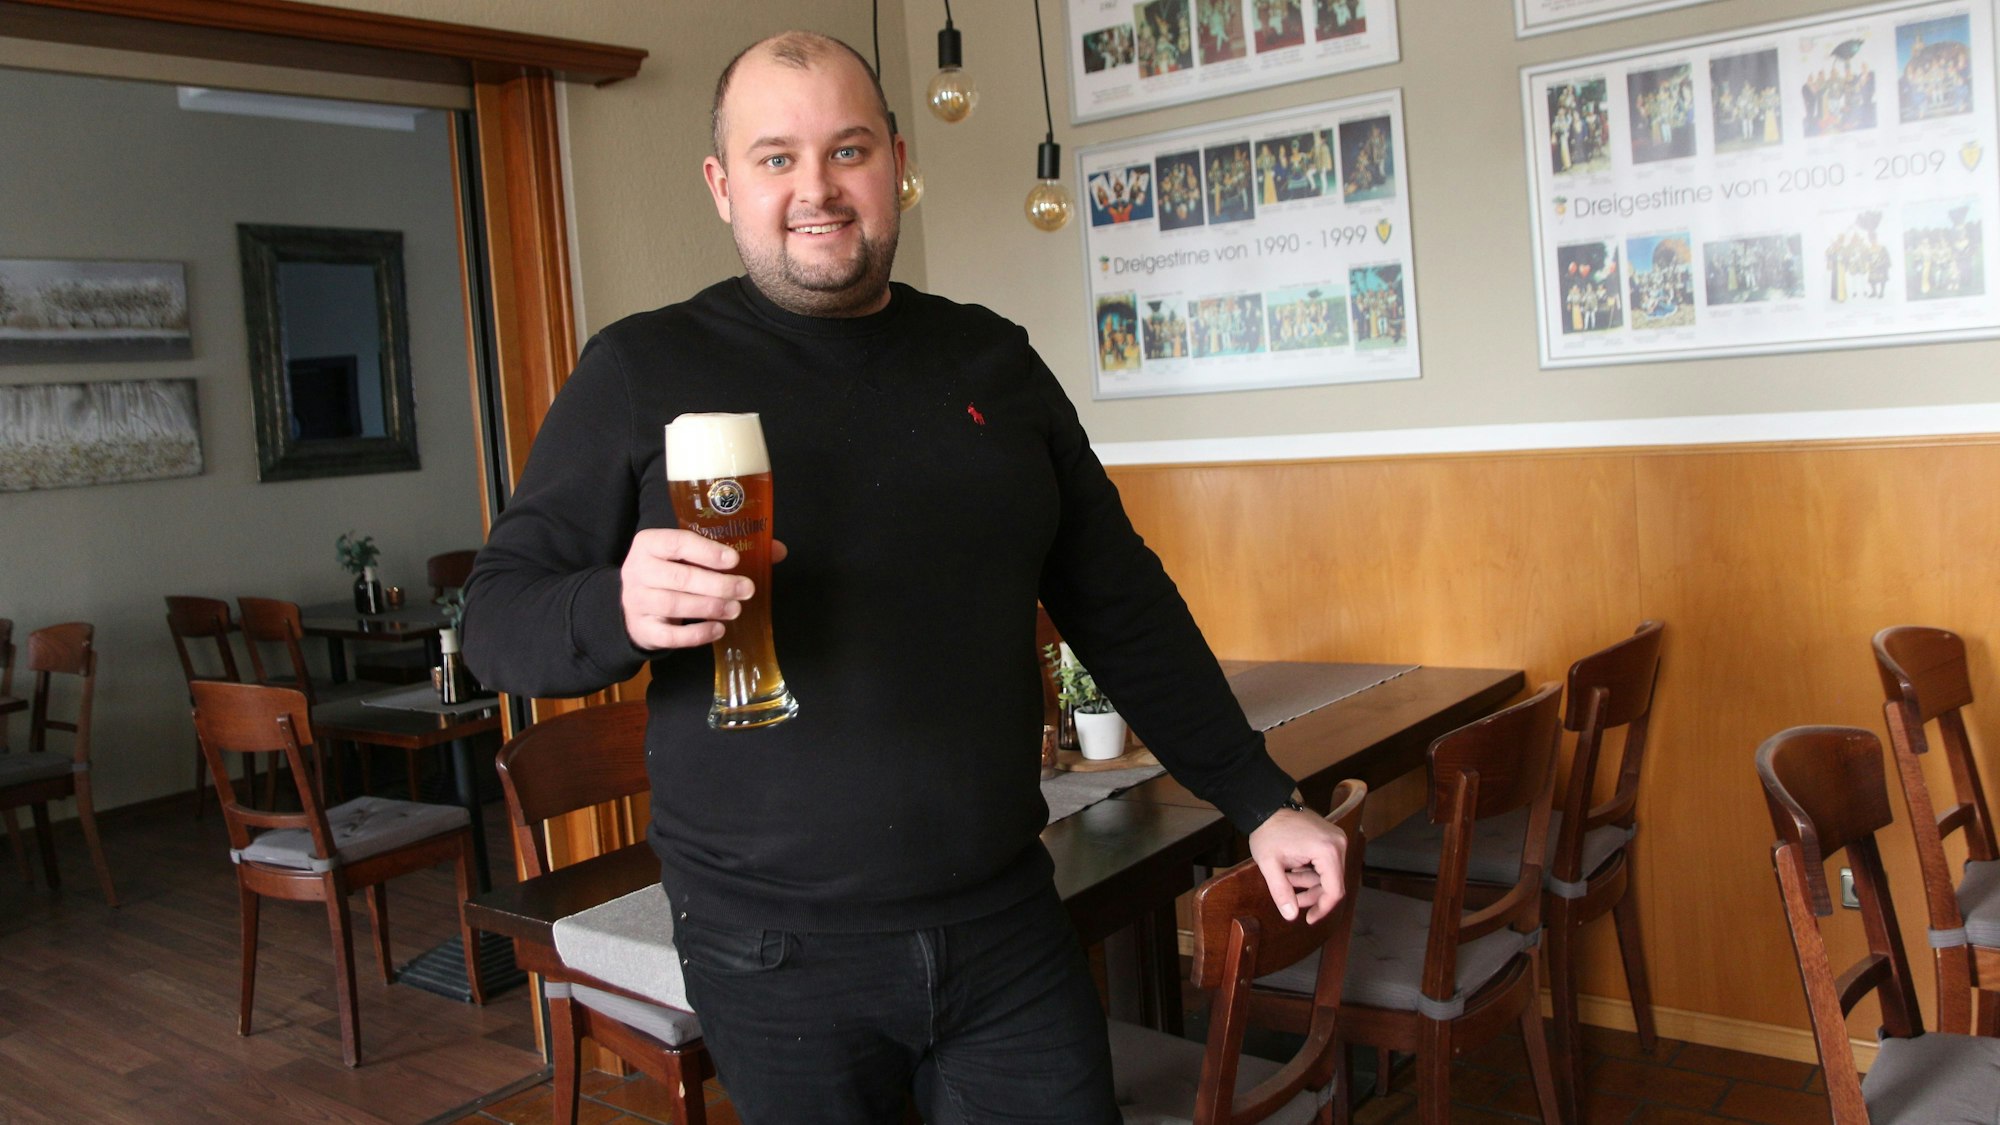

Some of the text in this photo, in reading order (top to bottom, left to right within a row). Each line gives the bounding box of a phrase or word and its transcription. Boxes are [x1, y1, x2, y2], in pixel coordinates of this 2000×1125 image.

[1574, 185, 1713, 219] Dreigestirne
[1720, 177, 1768, 199] von
[1778, 162, 1845, 194] 2000
[1874, 149, 1946, 180] 2009
[1113, 247, 1210, 276] Dreigestirne
[1215, 242, 1249, 261] von
[1255, 233, 1300, 257] 1990
[1320, 224, 1368, 249] 1999
